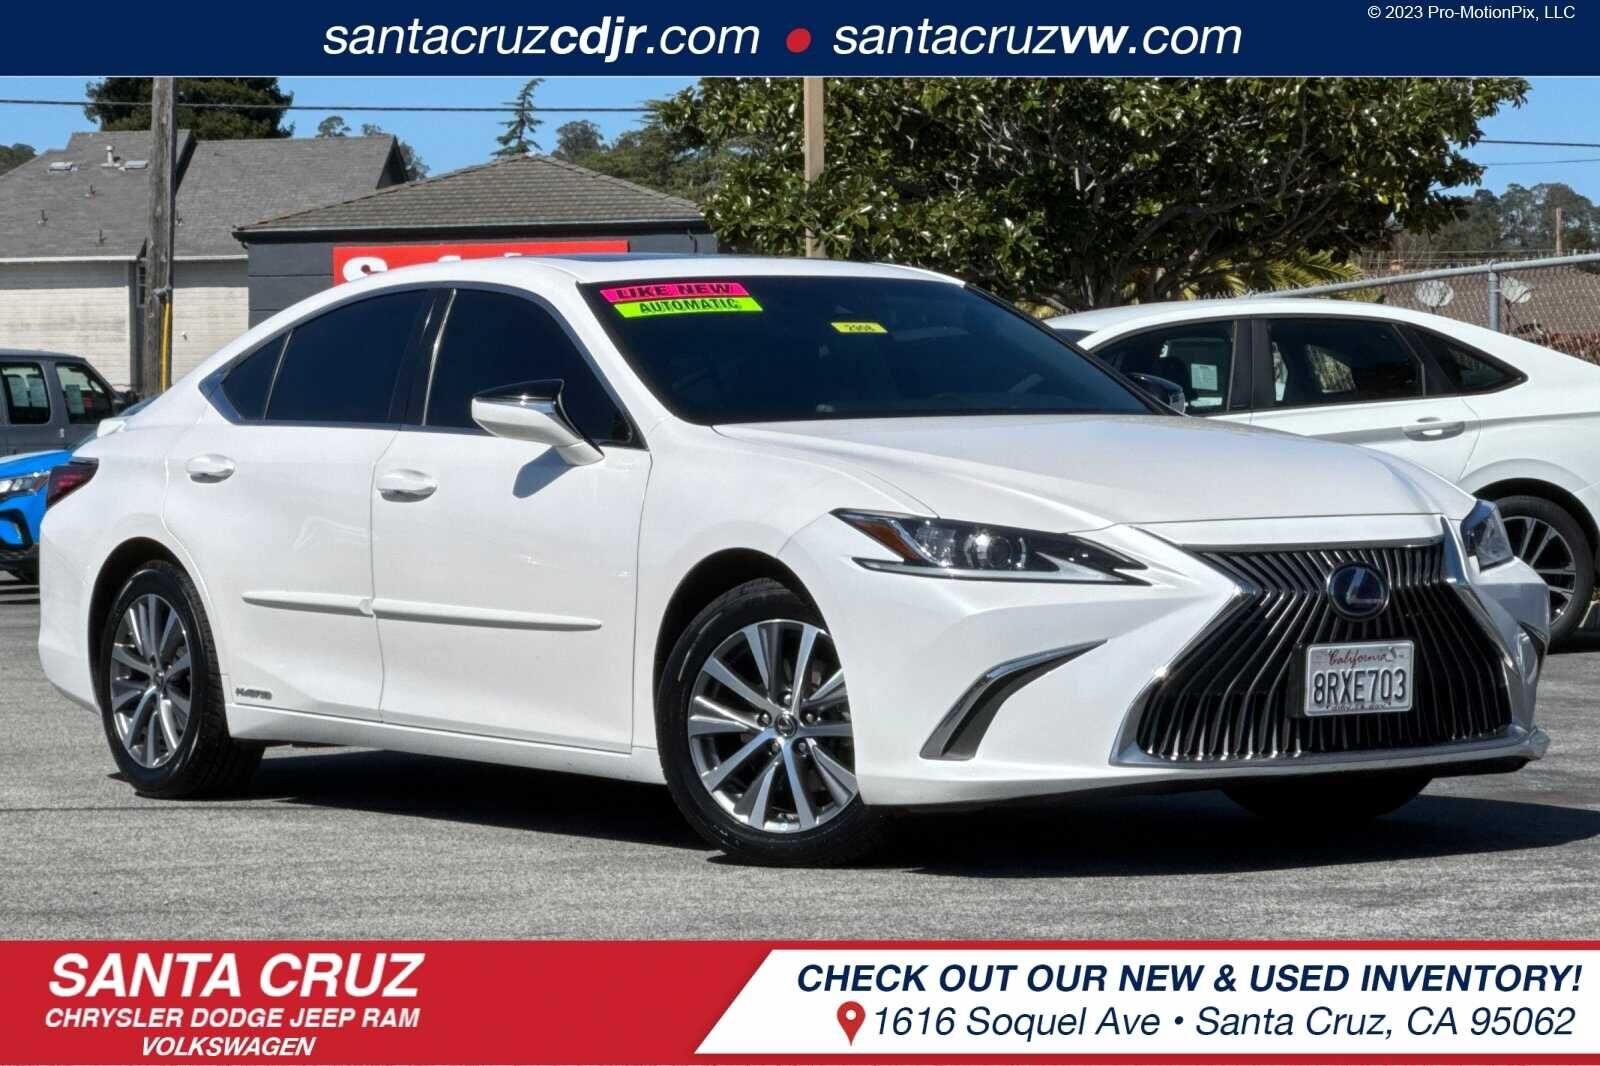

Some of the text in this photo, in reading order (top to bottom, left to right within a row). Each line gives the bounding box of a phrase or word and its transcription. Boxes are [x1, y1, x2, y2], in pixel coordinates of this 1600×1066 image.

[616, 284, 730, 299] LIKE NEW
[639, 297, 738, 314] AUTOMATIC
[1313, 668, 1407, 705] 8RXE703
